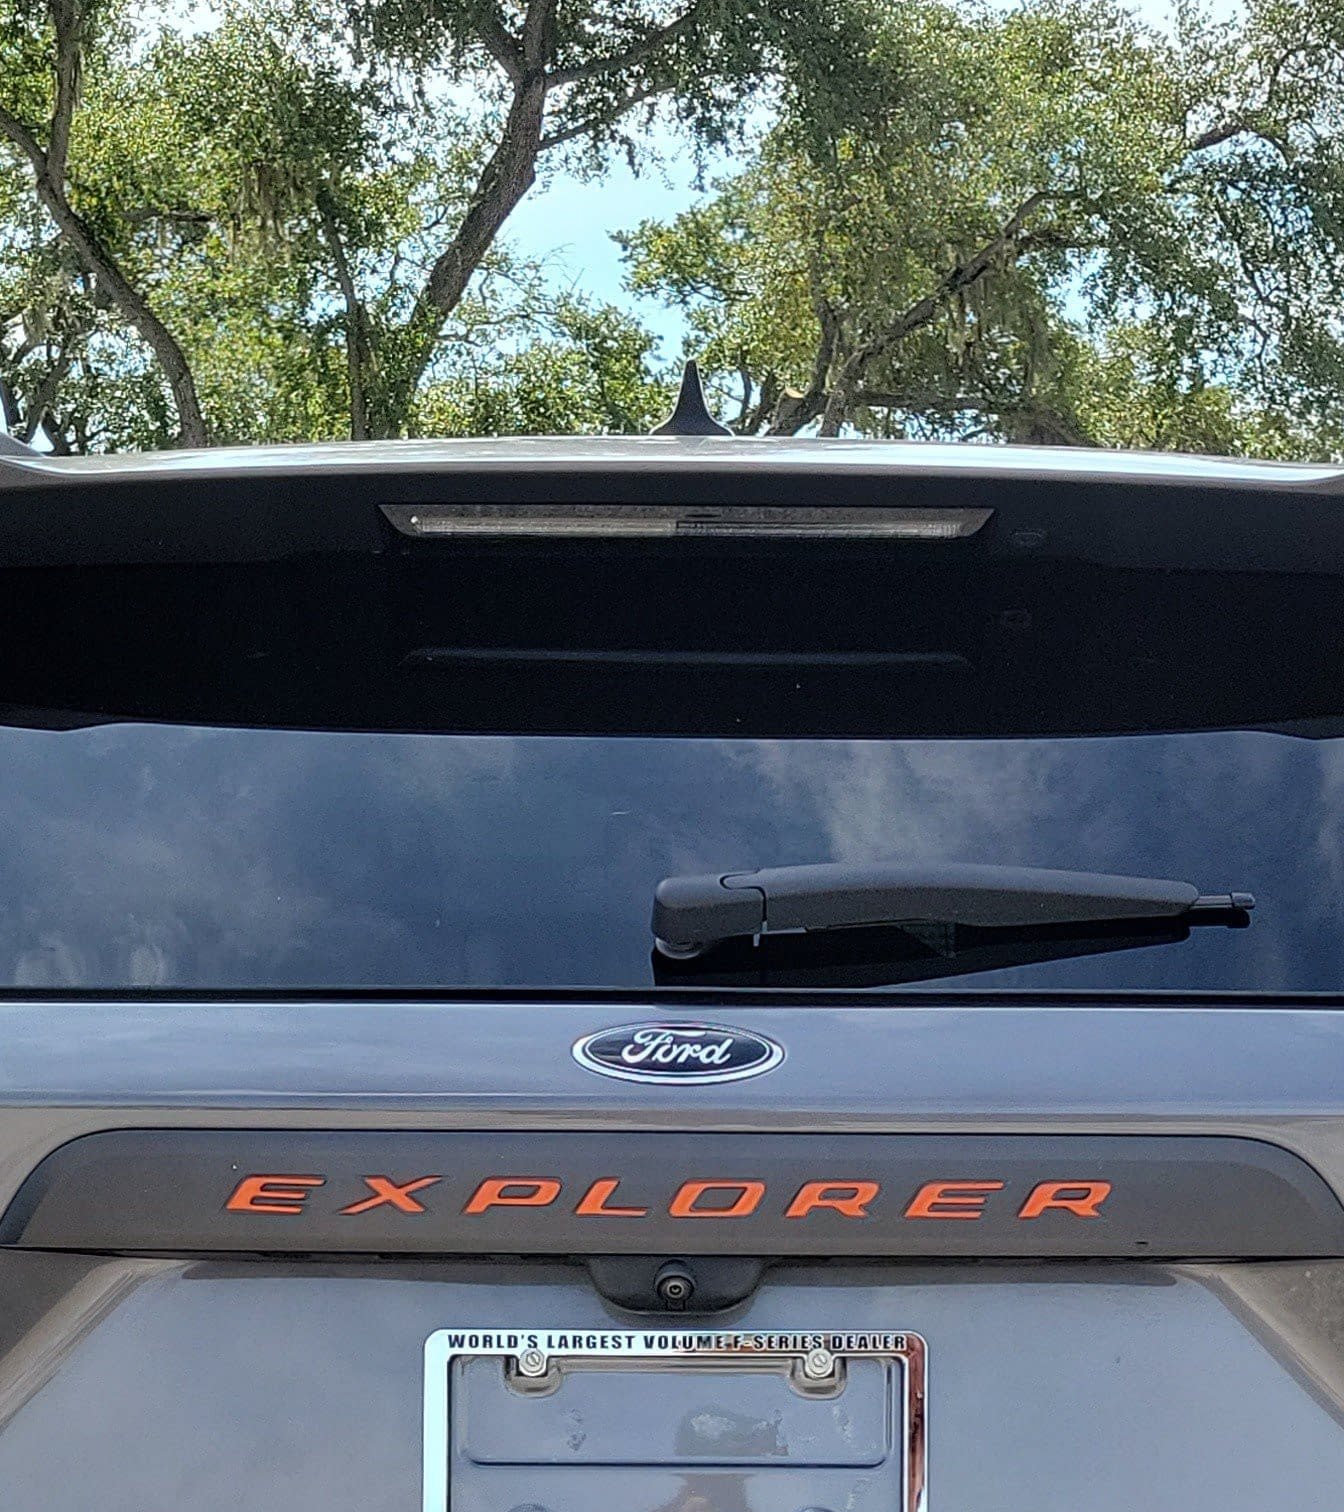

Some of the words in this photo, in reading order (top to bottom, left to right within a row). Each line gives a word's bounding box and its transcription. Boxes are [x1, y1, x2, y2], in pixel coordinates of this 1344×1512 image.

[621, 1028, 734, 1064] Ford
[225, 1174, 1114, 1220] EXPLORER
[447, 1334, 538, 1350] WORLD'S
[547, 1334, 636, 1350] LARGEST
[643, 1335, 725, 1350] VOLUME
[733, 1335, 826, 1350] F-SERIES
[831, 1335, 906, 1351] DEALER
